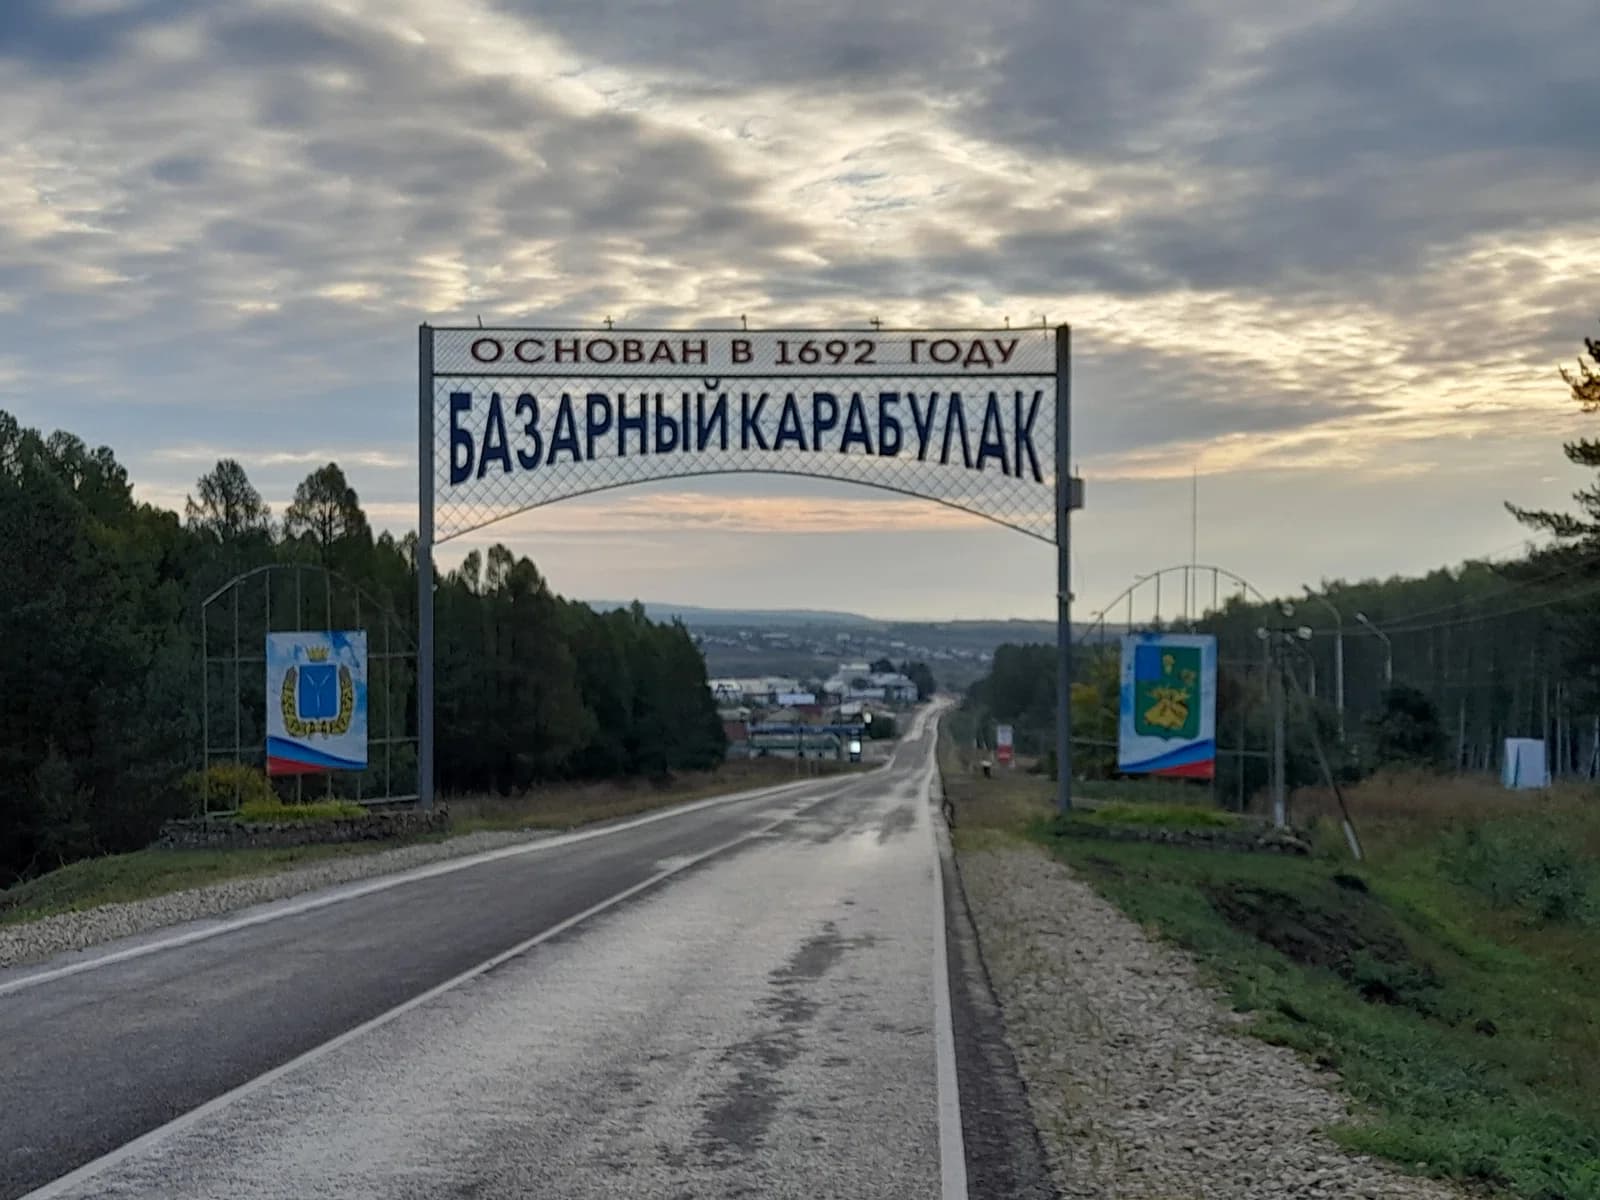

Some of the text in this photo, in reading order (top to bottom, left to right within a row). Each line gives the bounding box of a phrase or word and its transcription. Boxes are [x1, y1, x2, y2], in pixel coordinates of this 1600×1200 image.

[470, 338, 1020, 366] ОСНОВАН В 1692 ГОДУ
[449, 378, 1044, 487] БАЗАРНЫЙ КАРАБУЛАК
